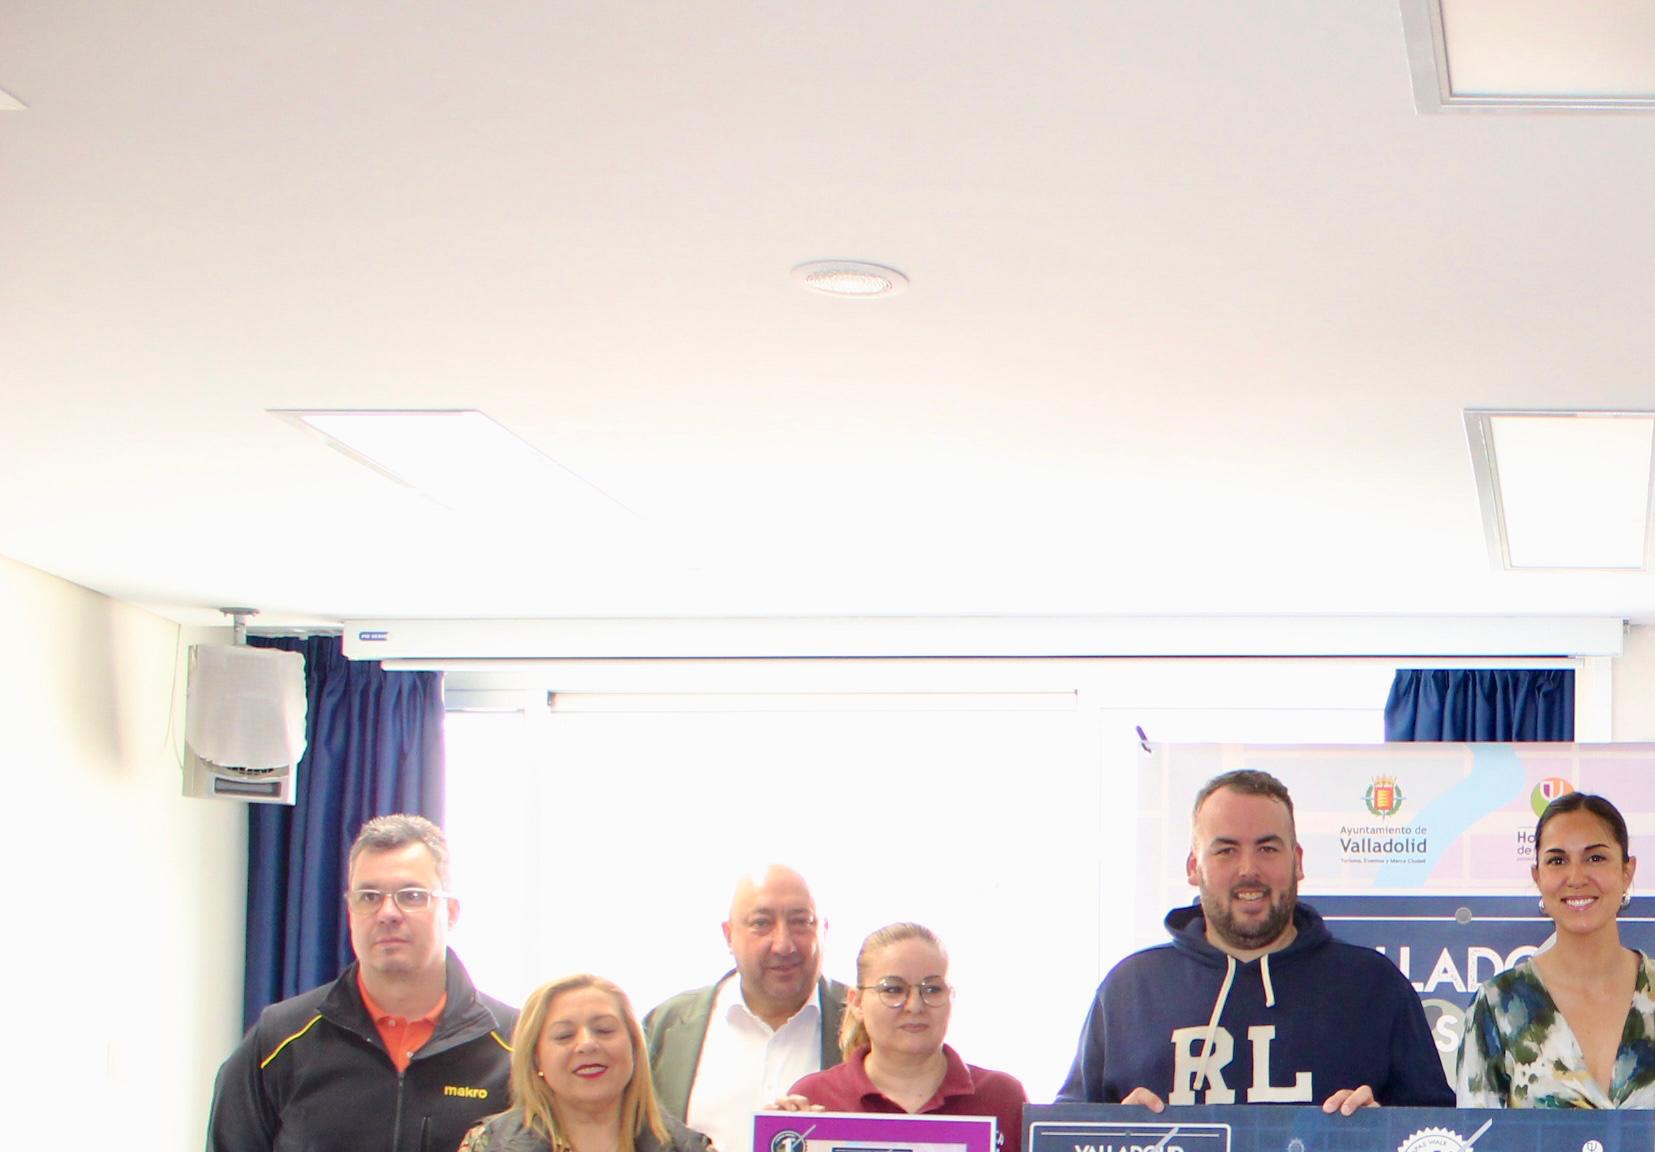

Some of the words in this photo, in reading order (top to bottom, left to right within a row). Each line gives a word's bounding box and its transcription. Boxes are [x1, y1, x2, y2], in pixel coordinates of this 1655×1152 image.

[1340, 825, 1412, 836] Ayuntamiento
[1415, 825, 1428, 834] de
[1340, 838, 1427, 853] Valladolid
[1517, 845, 1531, 855] de
[1169, 1024, 1313, 1104] RL
[444, 1085, 488, 1099] makro
